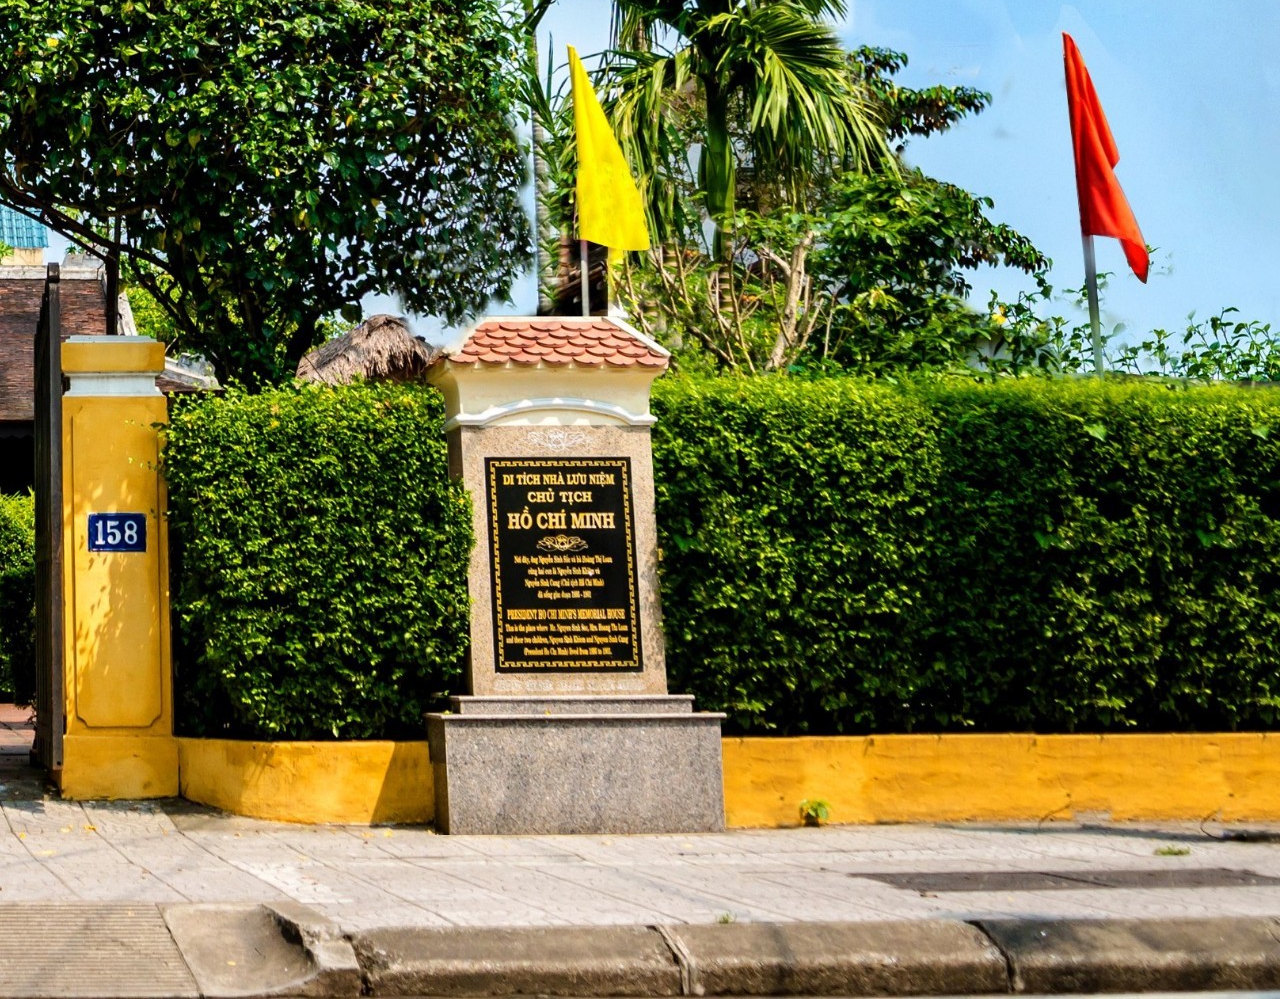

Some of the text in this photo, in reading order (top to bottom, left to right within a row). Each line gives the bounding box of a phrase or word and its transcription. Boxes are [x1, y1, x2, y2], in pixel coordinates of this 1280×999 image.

[503, 471, 615, 487] DI TÍCH NHÀ LƯU NIỆM
[527, 488, 592, 505] CHỦ TỊCH
[507, 506, 616, 529] HỒ CHÍ MINH
[95, 520, 138, 545] 158
[507, 609, 537, 620] PRESIDENT
[538, 609, 546, 620] HO
[547, 609, 557, 620] CHI
[577, 609, 606, 620] MEMORIAL
[607, 609, 625, 620] HOUSE
